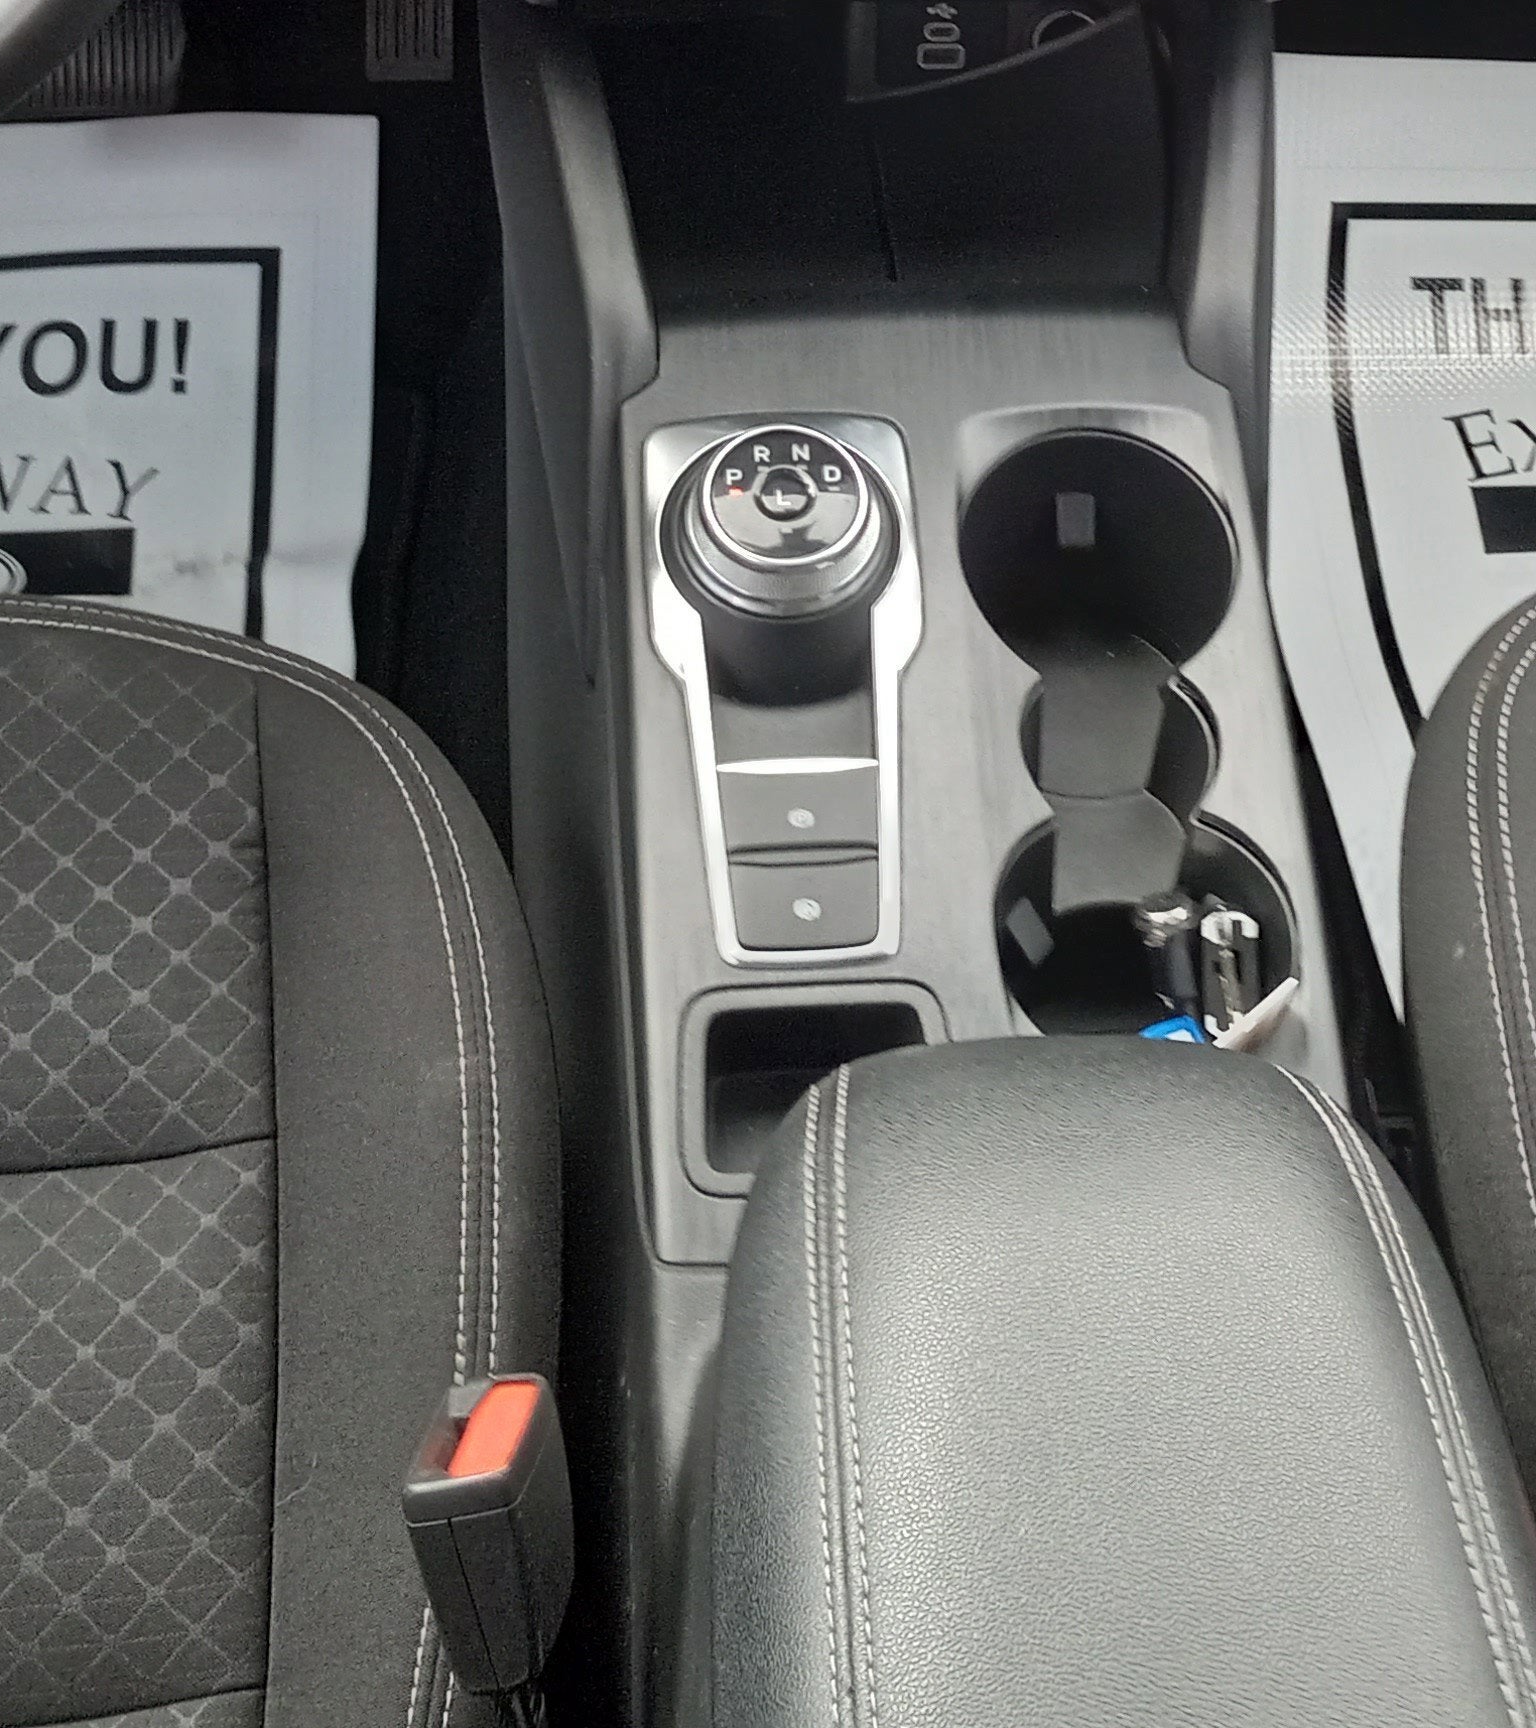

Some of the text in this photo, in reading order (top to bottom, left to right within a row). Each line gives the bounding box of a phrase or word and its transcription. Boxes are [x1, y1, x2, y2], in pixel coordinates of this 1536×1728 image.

[725, 443, 842, 486] P R N D
[775, 489, 792, 507] L
